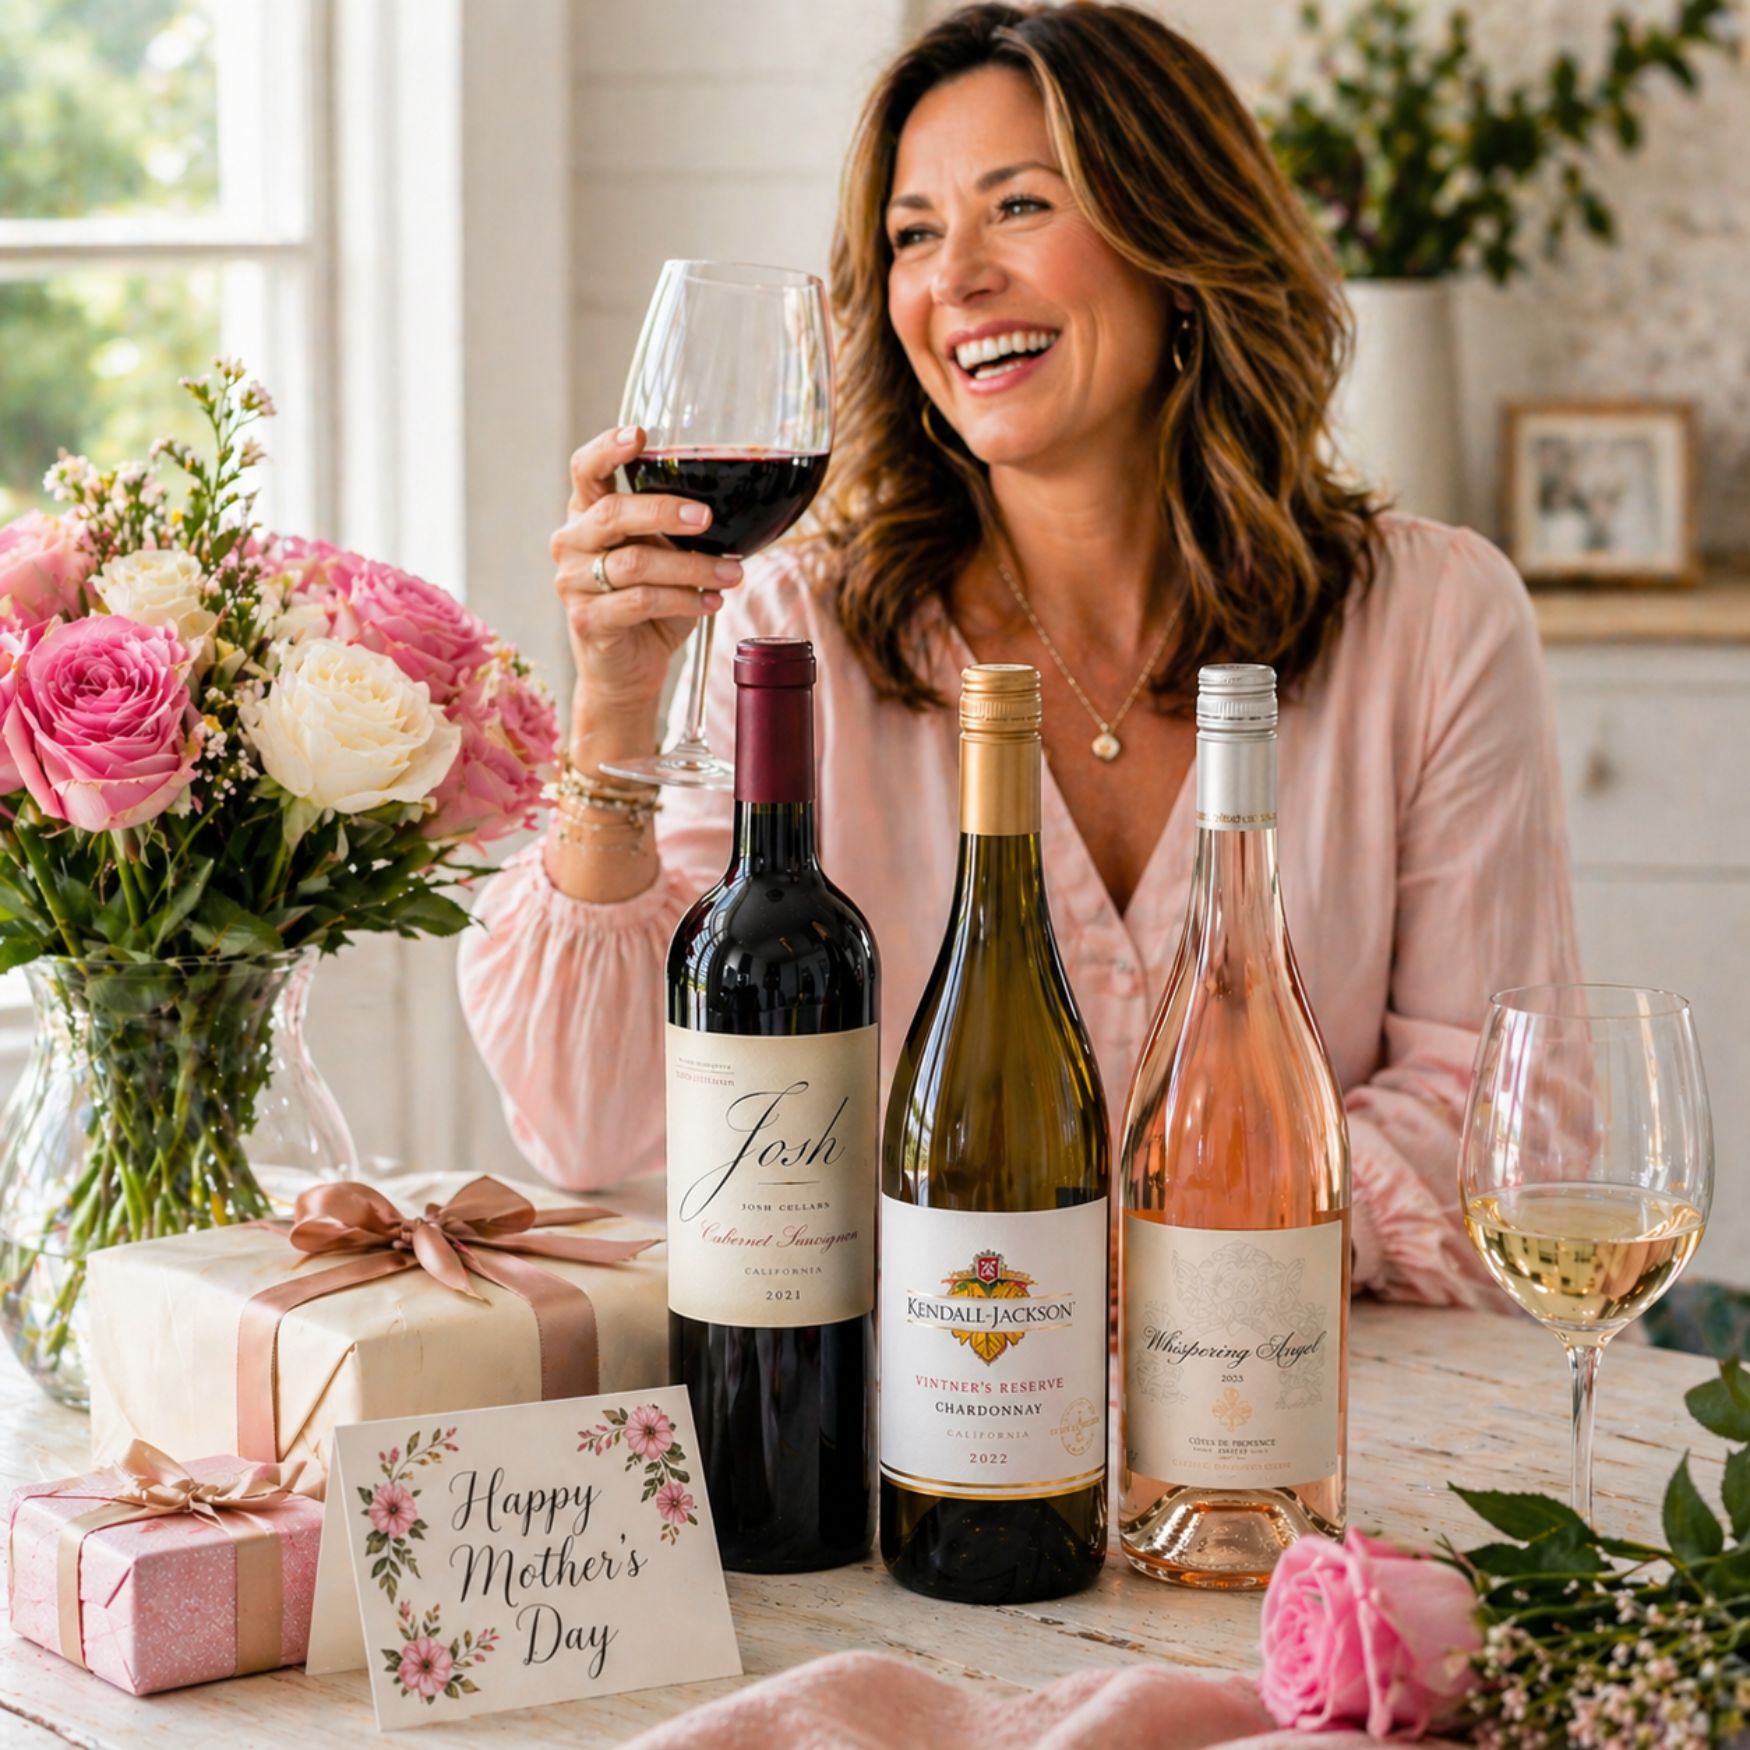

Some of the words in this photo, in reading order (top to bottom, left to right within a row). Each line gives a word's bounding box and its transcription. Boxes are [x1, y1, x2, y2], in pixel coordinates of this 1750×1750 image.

[679, 1080, 848, 1222] Josh
[741, 1202, 771, 1212] JOSH
[779, 1202, 830, 1212] CELLARS
[700, 1219, 773, 1248] Cabernet
[776, 1224, 859, 1256] Sauvignon
[744, 1266, 822, 1275] CALIFORNIA
[766, 1290, 801, 1301] 2021
[907, 1296, 1074, 1328] KENDALL-JACKSON
[1256, 1331, 1328, 1369] Angel
[915, 1375, 992, 1394] VINTNER'S
[1000, 1377, 1064, 1394] RESERVE
[935, 1402, 1042, 1416] CHARDONNAY
[947, 1429, 1029, 1439] CALIFORNIA
[969, 1453, 1008, 1464] 2022
[449, 1467, 602, 1537] Happy
[449, 1533, 648, 1608] Mother's
[515, 1603, 620, 1680] Day
